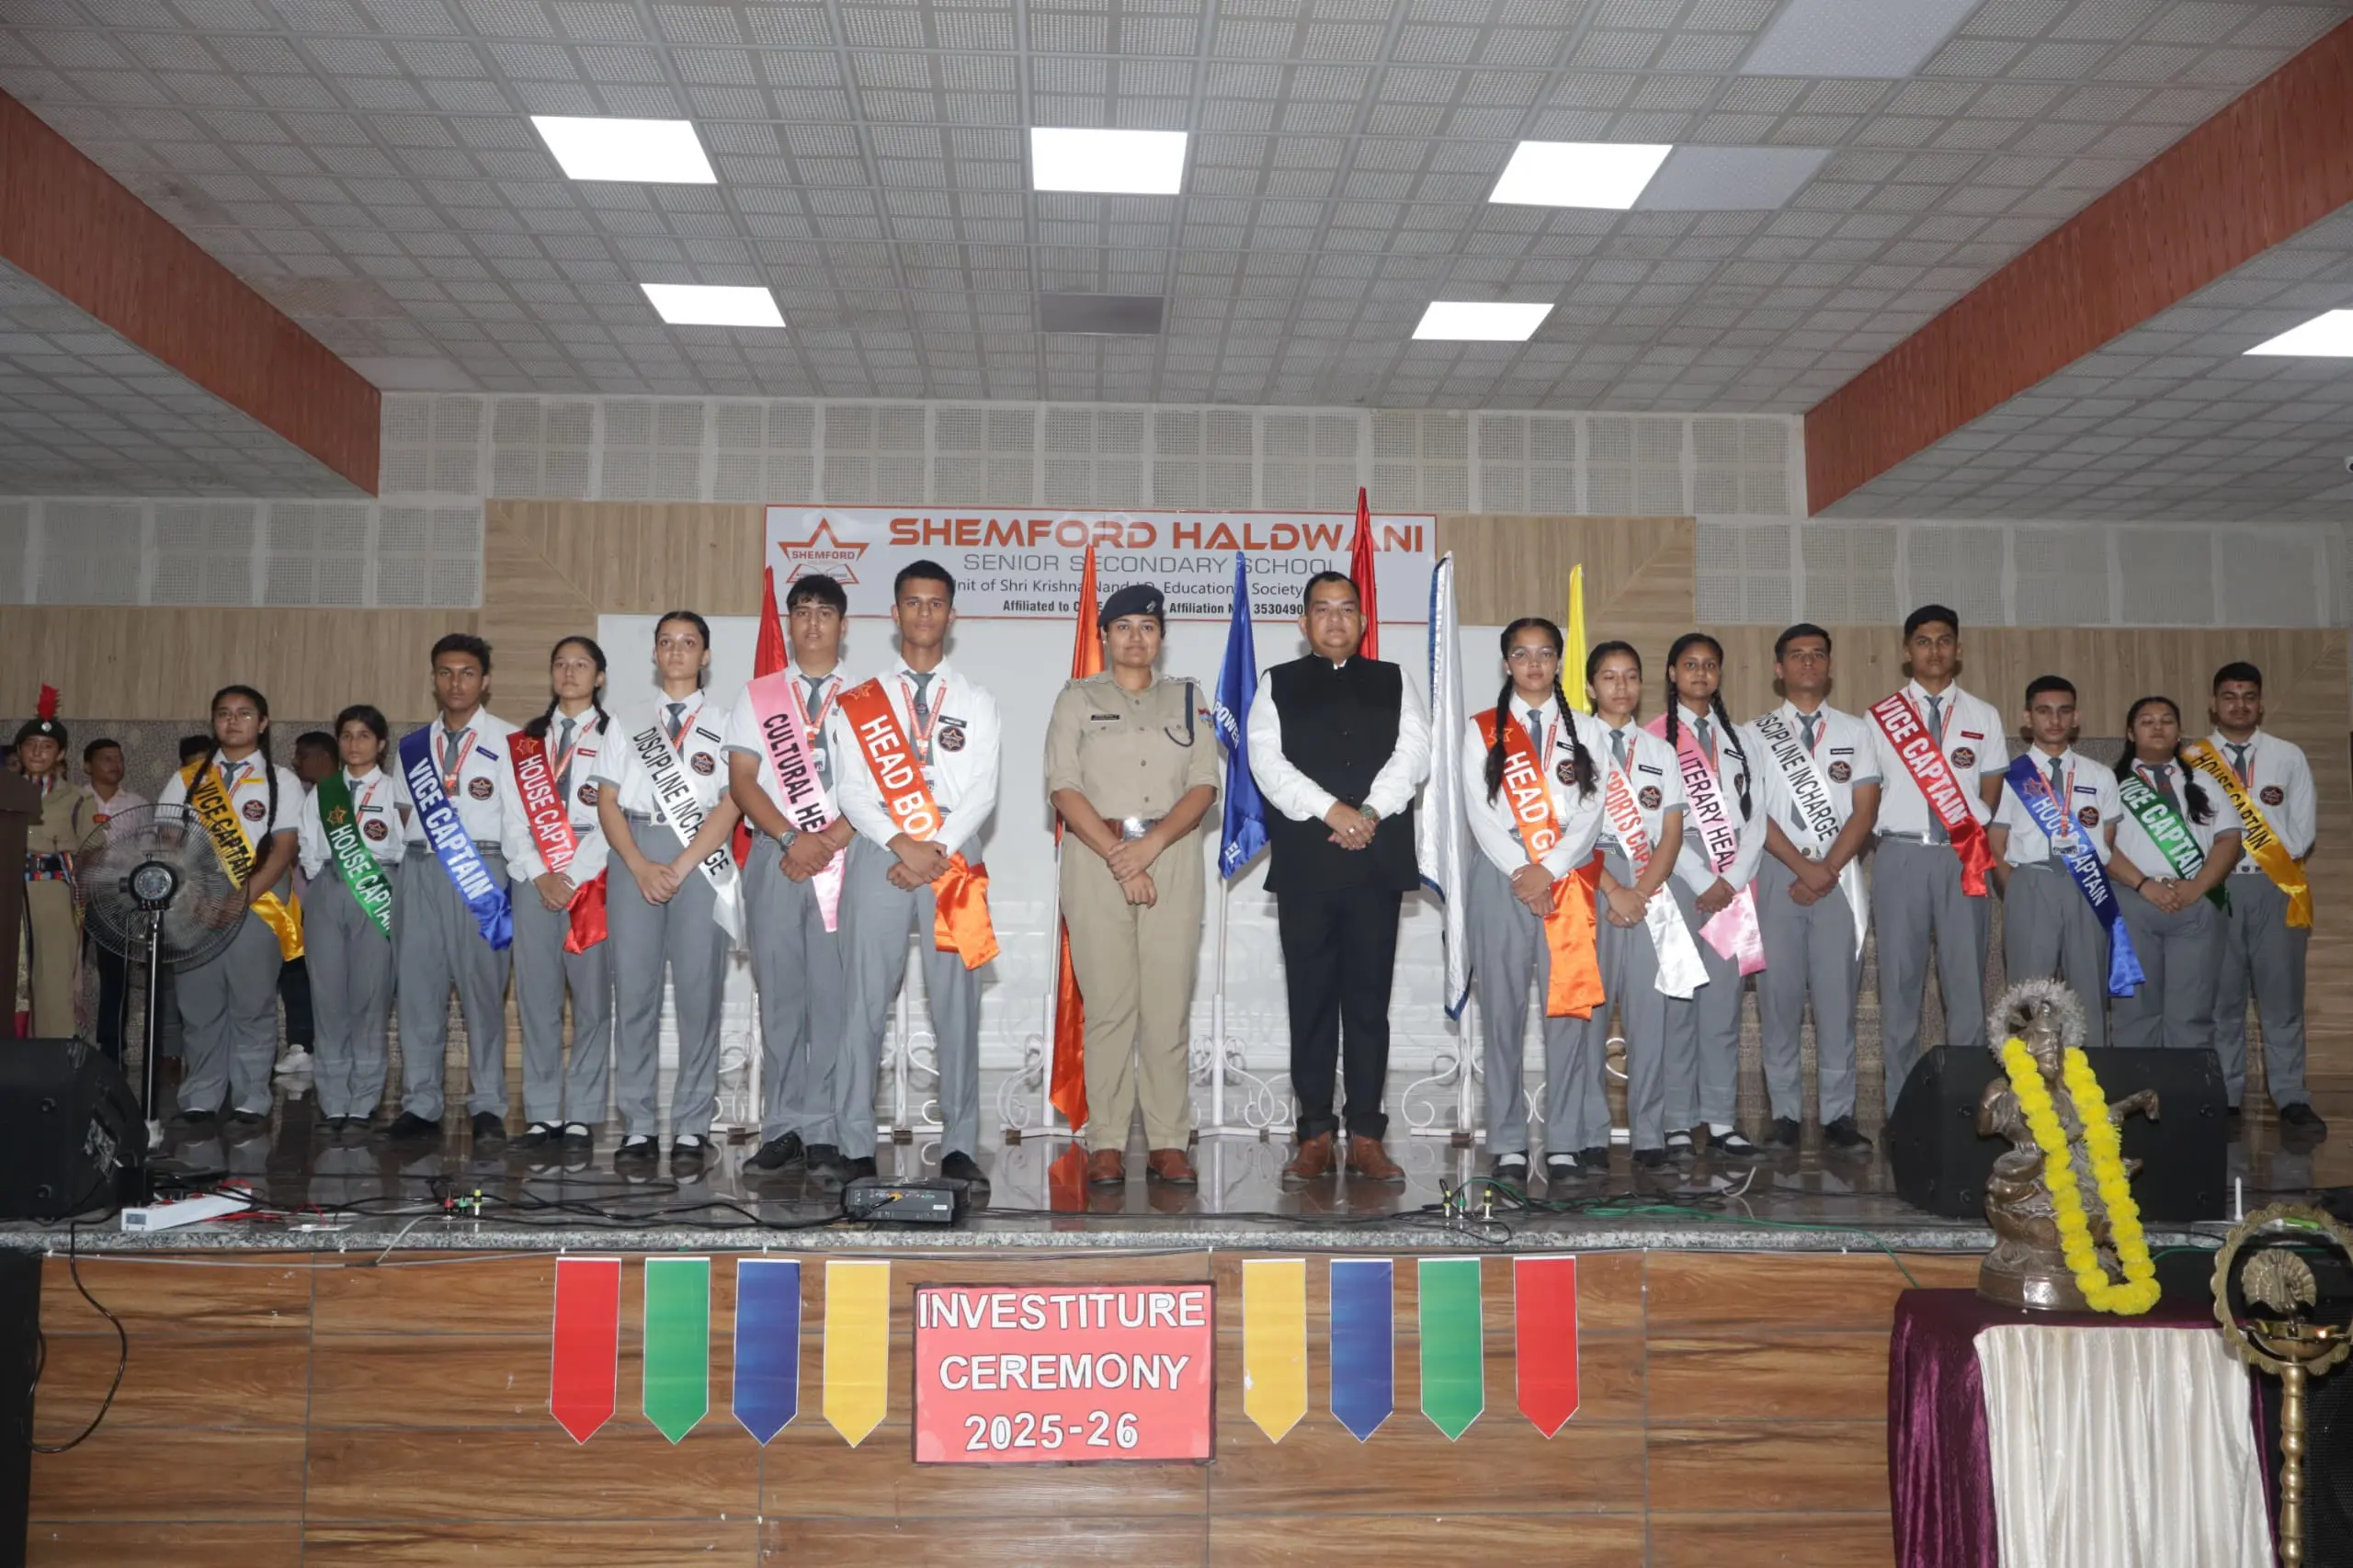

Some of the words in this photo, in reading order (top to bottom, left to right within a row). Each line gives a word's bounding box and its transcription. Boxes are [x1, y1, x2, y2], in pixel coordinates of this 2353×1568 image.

[791, 551, 856, 560] SHEMFORD
[889, 518, 1157, 549] SHEMFORD
[955, 579, 976, 591] nit
[981, 578, 996, 591] of
[1000, 579, 1028, 592] Shri
[1164, 582, 1234, 595] Education
[1252, 582, 1304, 598] Society
[964, 553, 1059, 571] SENIOR
[1003, 600, 1054, 611] Affiliated
[1059, 602, 1069, 611] to
[1169, 602, 1224, 614] Affiliation
[1254, 603, 1303, 615] 3530490
[763, 713, 813, 804] CULTURAL
[795, 802, 826, 832] HE
[860, 714, 914, 790] HEAD
[1754, 713, 1806, 771] ISCIPLINE
[1788, 767, 1839, 842] INCHARGE
[1874, 695, 1919, 744] VICE
[1903, 736, 1970, 825] CAPTAIN
[518, 755, 555, 812] HOUSE
[632, 726, 689, 803] DISCIPLINE
[670, 797, 729, 876] INCHGE
[1504, 751, 1549, 823] HEAD
[1606, 770, 1642, 832] SPORTS
[329, 824, 371, 879] HOUSE
[407, 757, 444, 812] VICE
[426, 807, 494, 901] CAPTAIN
[918, 1291, 1206, 1331] INVESTITURE
[938, 1353, 1190, 1391] CEREMONY
[964, 1409, 1139, 1451] 2025-26
